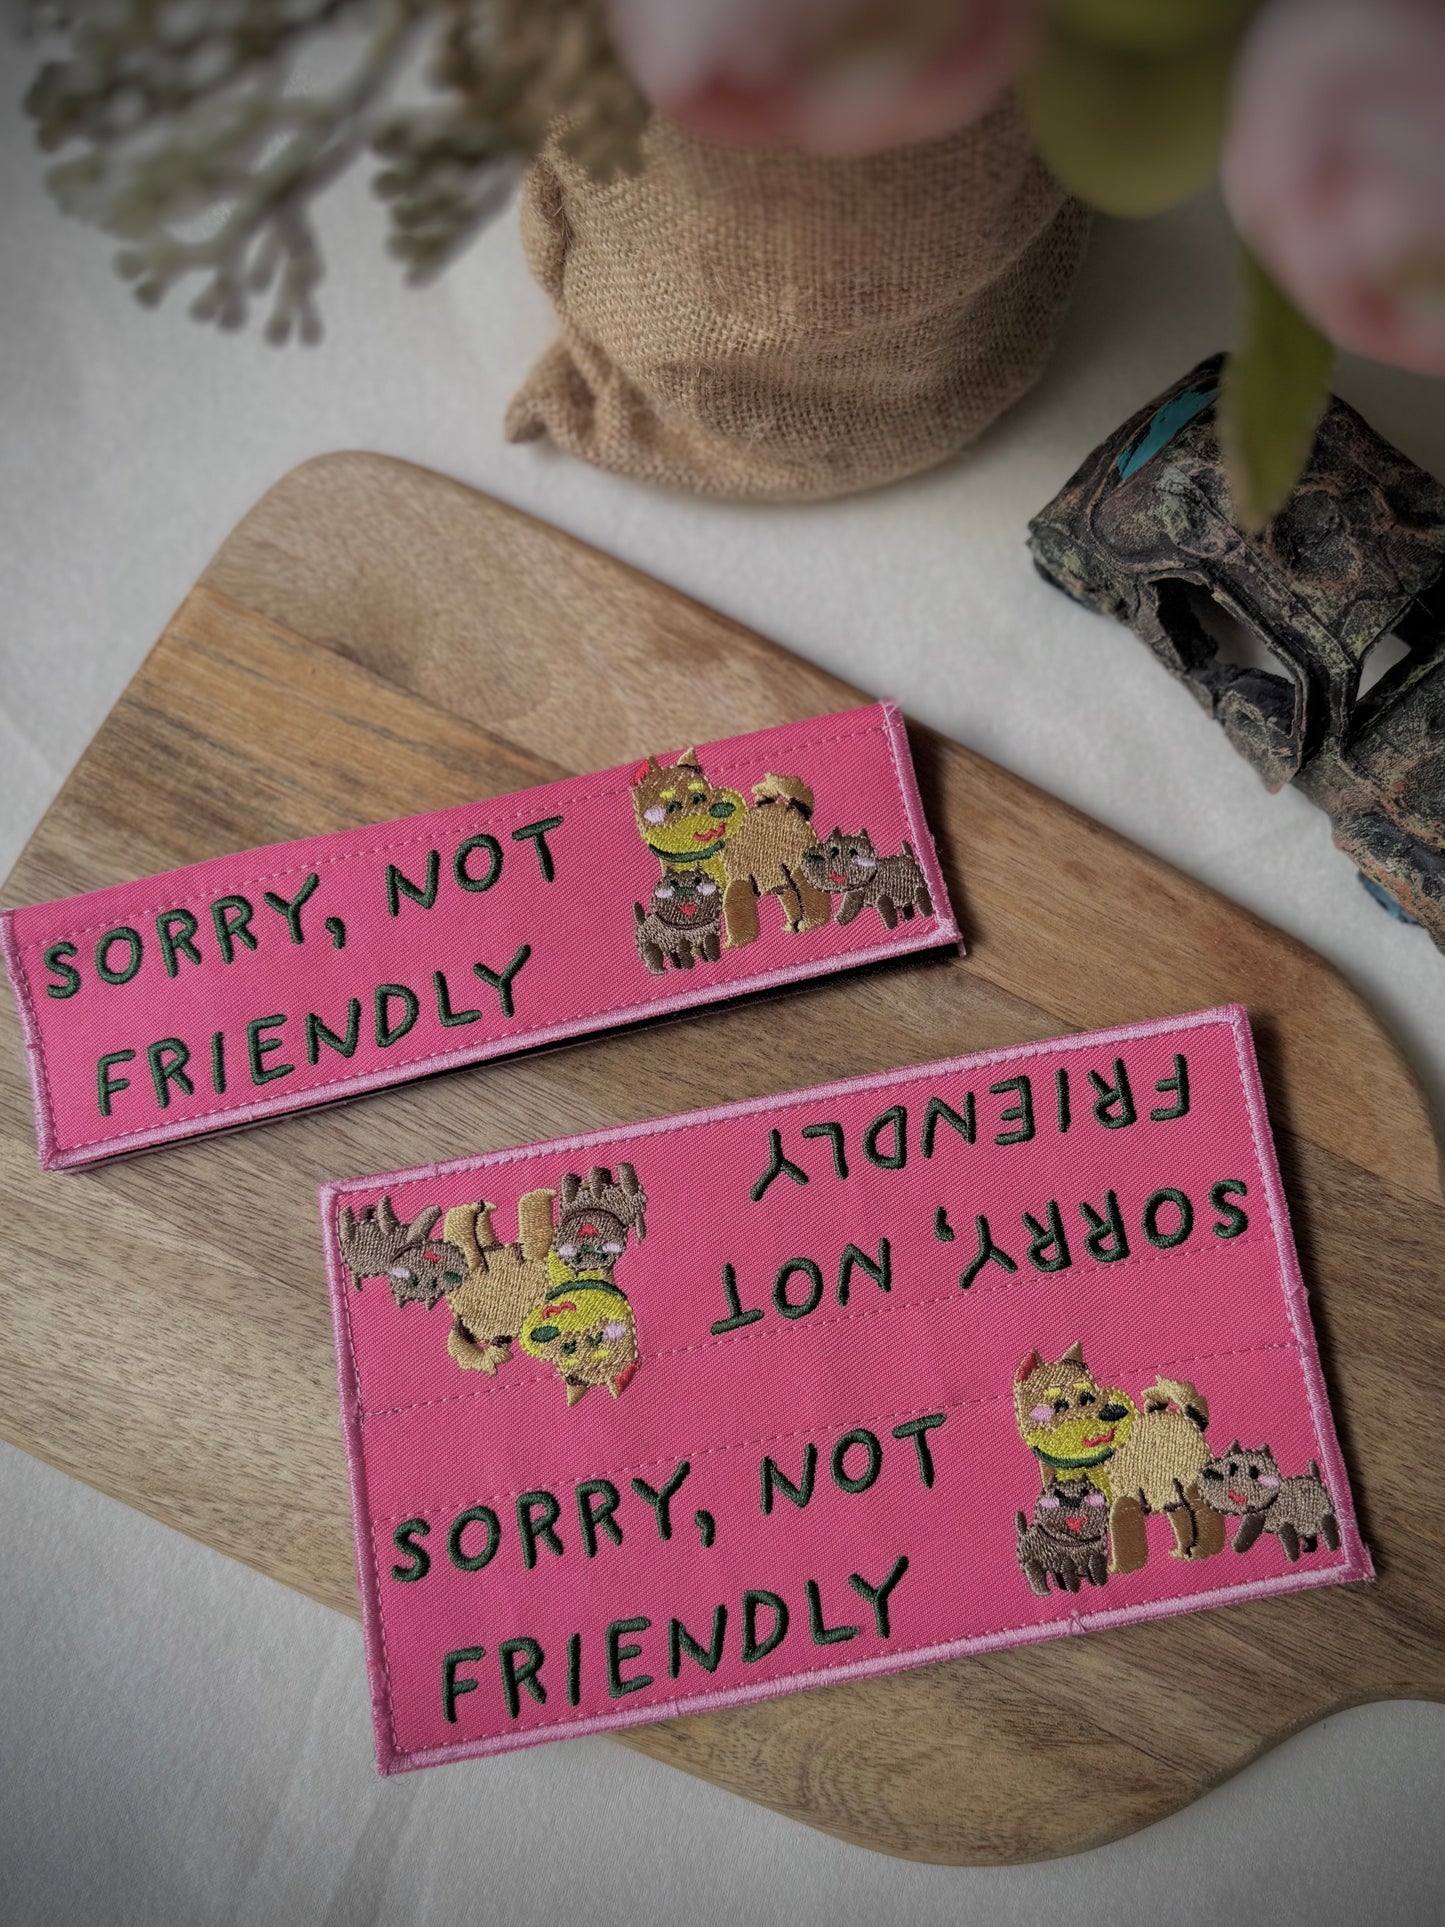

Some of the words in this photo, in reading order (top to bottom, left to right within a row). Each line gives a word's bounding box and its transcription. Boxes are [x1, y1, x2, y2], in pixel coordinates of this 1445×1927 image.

[43, 873, 346, 999] SORRY,
[385, 815, 564, 917] NOT
[97, 944, 532, 1117] FRIENDLY
[750, 1053, 1191, 1202] FRIENDLY
[710, 1238, 893, 1336] NOT
[933, 1179, 1249, 1289] SORRY,
[390, 1460, 716, 1584] SORRY,
[759, 1412, 947, 1515] NOT
[441, 1555, 910, 1725] FRIENDLY
